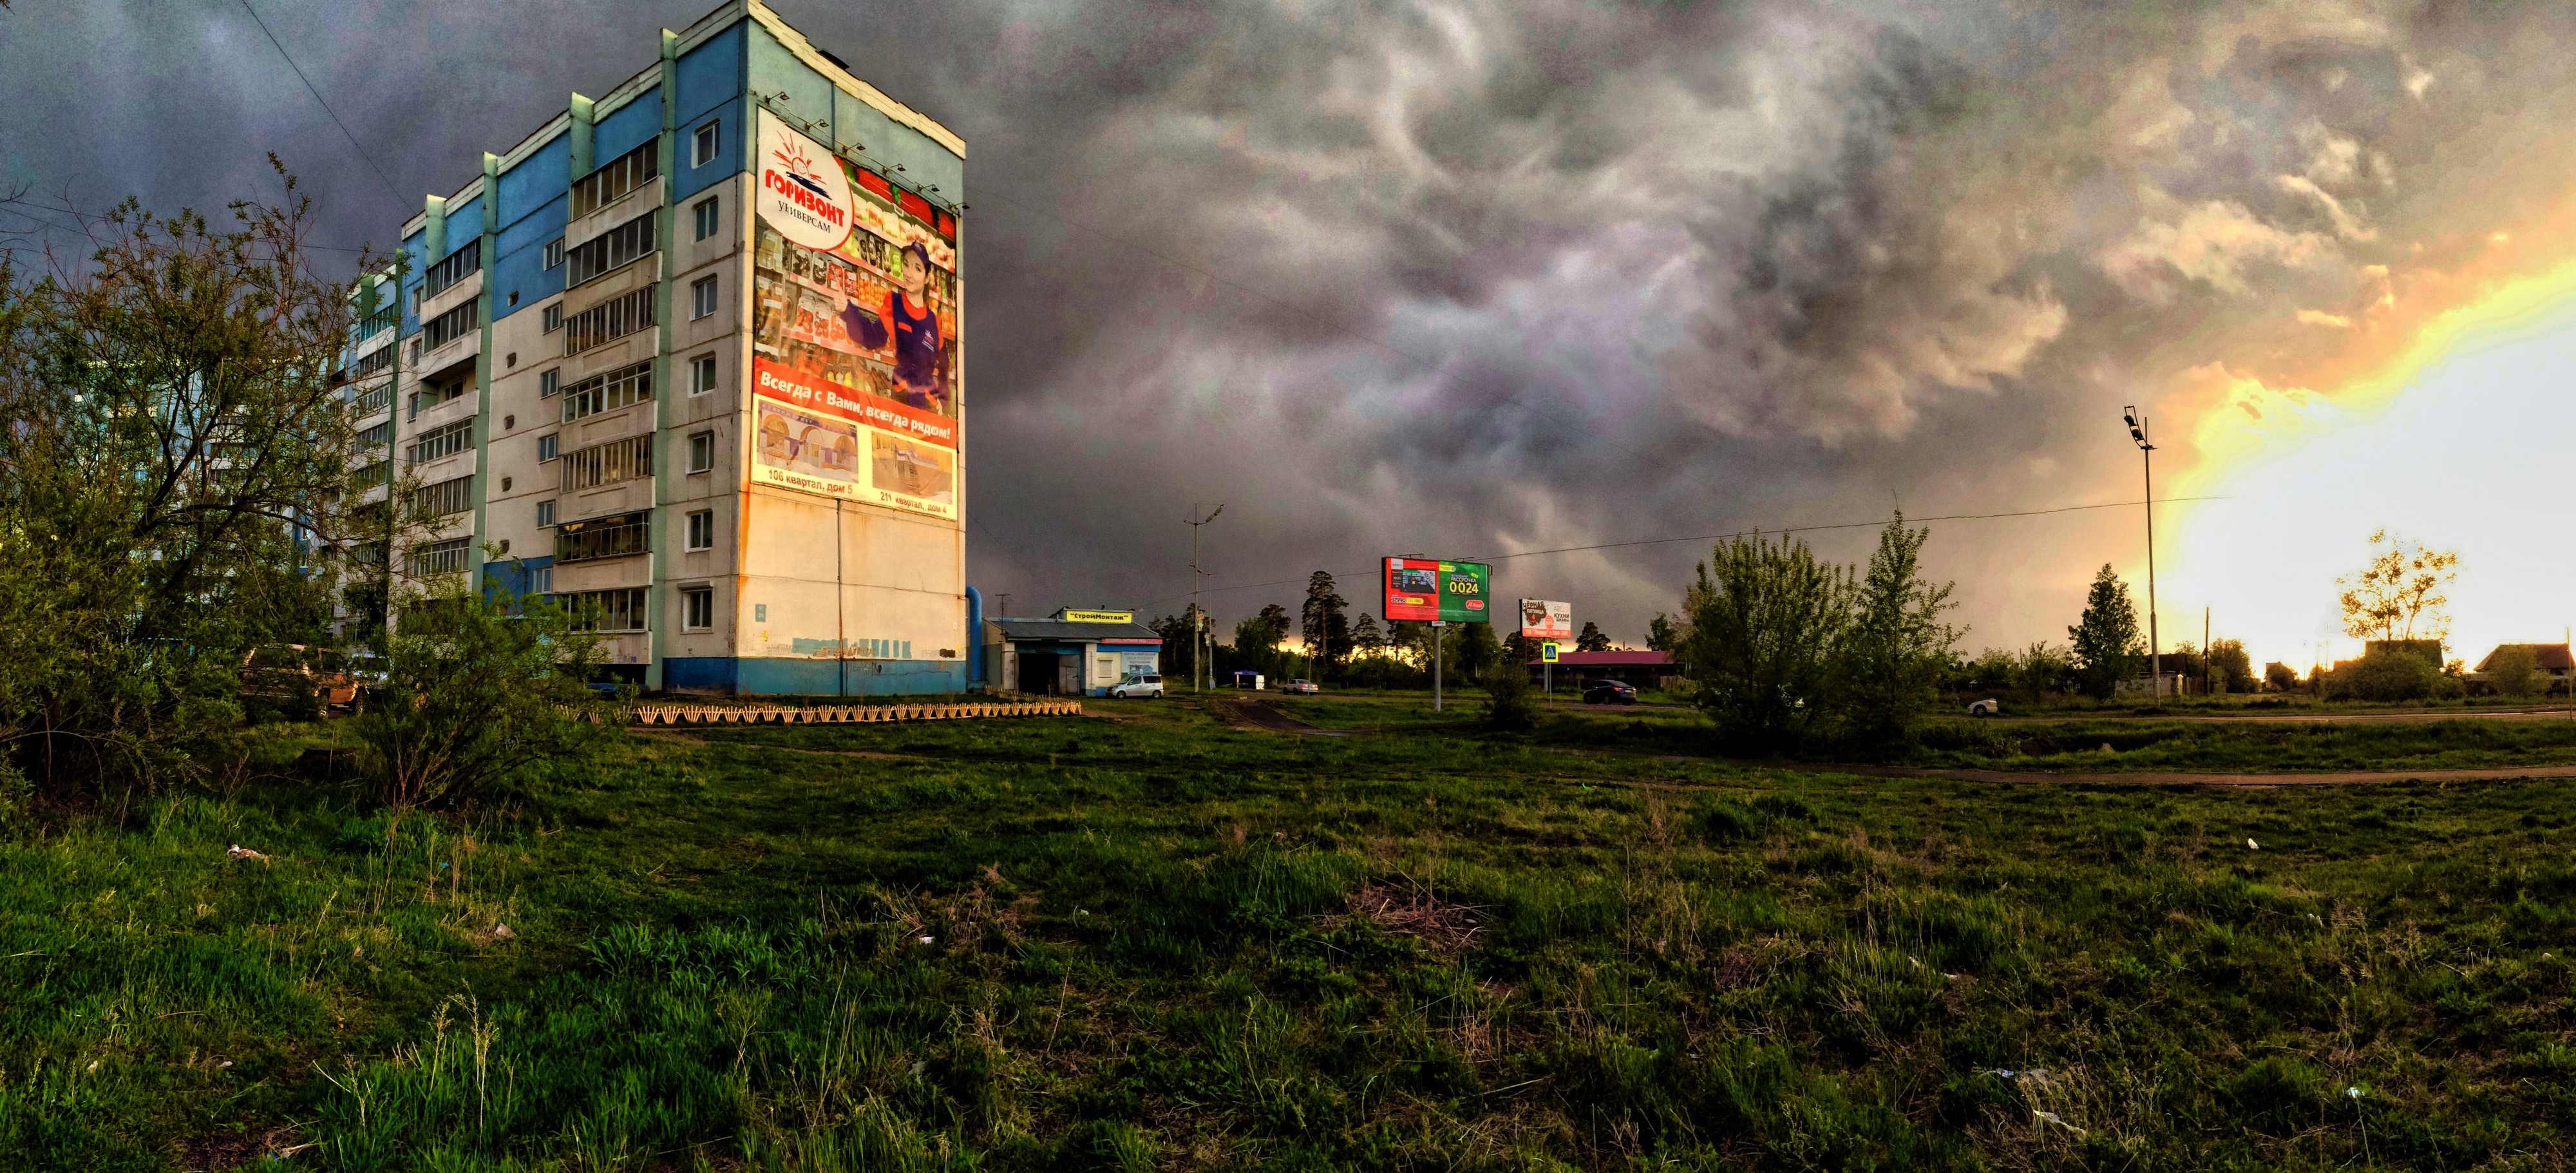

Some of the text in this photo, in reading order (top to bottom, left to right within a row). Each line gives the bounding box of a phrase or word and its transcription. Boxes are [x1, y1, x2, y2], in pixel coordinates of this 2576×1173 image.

[765, 169, 844, 227] ГОРИЗОНТ
[777, 200, 831, 233] УНИВЕРСАМ
[761, 371, 951, 439] Всегда с Вами, всегда рядом!
[768, 470, 852, 494] 106 квартал, дом 5
[880, 491, 891, 502] 211
[928, 505, 941, 514] дом
